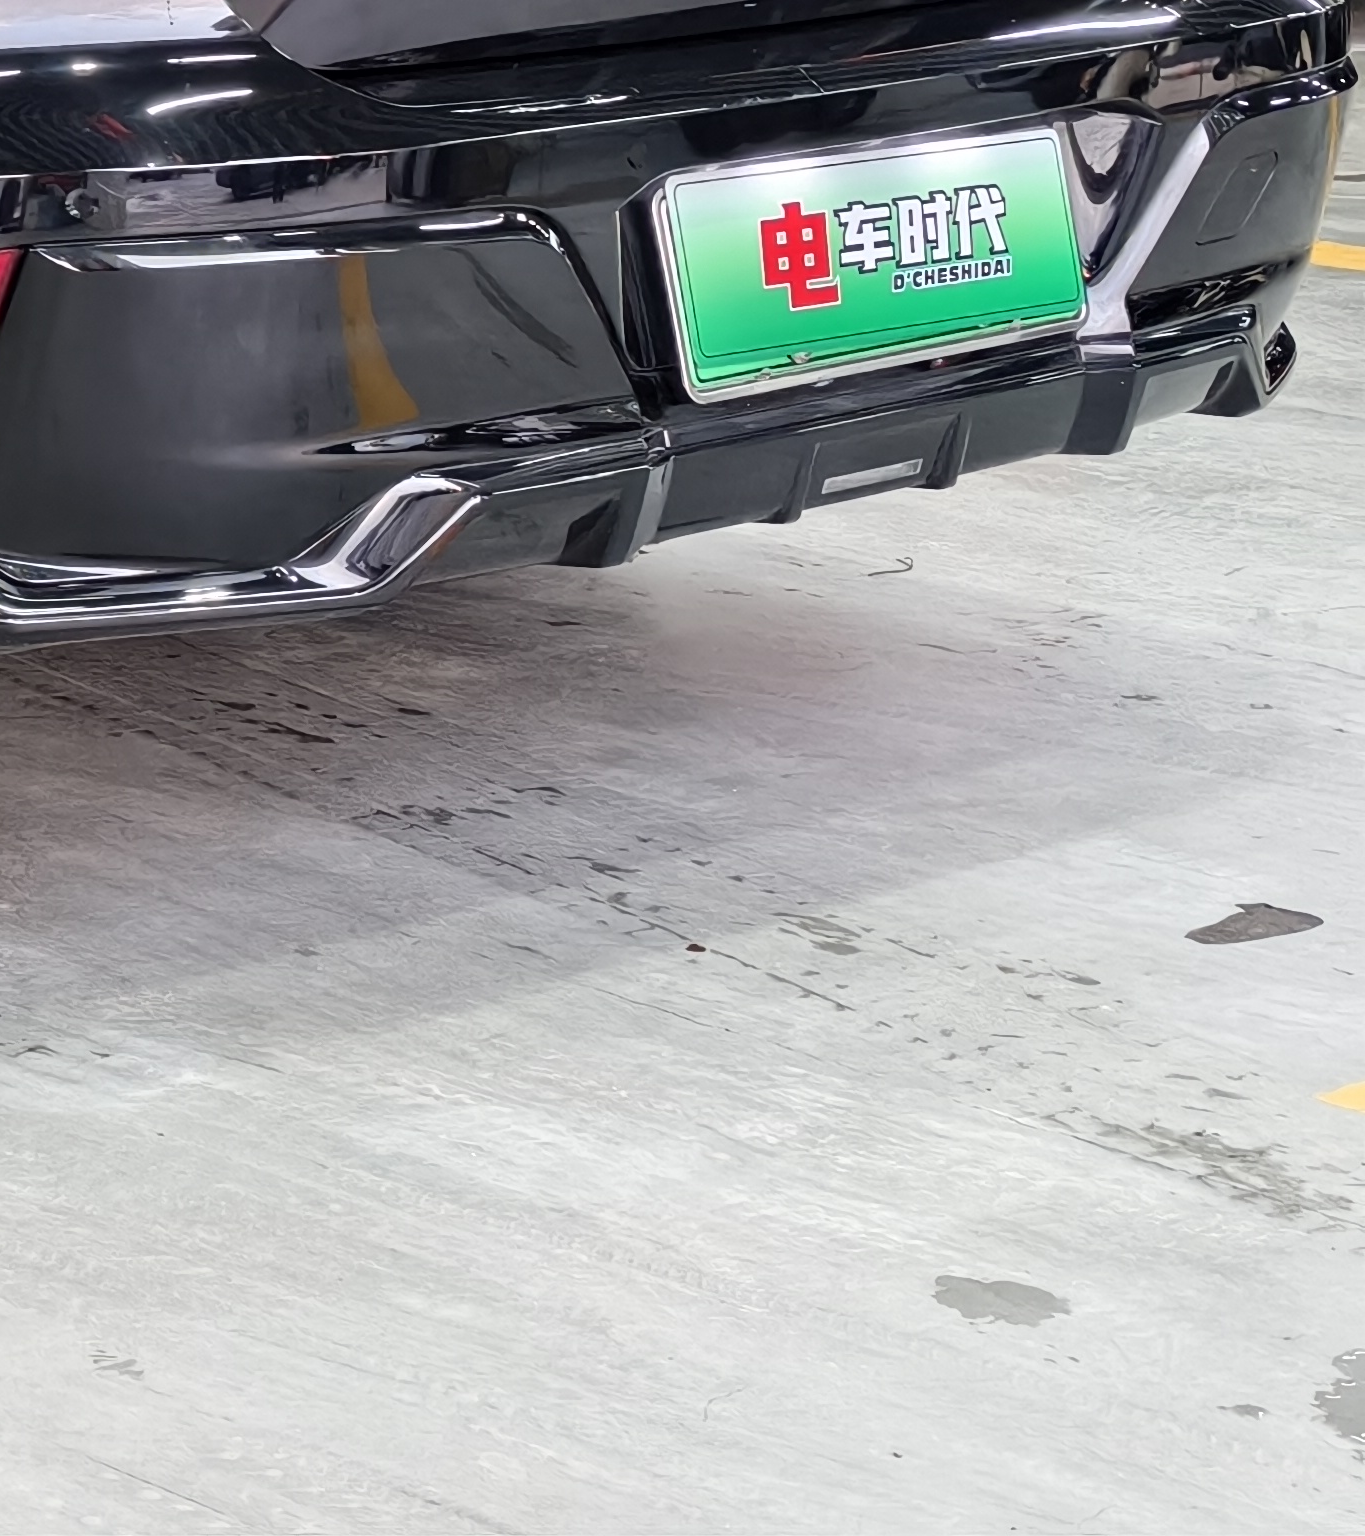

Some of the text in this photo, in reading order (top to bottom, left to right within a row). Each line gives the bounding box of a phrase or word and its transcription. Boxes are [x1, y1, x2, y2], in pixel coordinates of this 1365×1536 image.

[758, 184, 1007, 311] 电车时代
[891, 256, 1013, 293] D'CHESHIDAI
